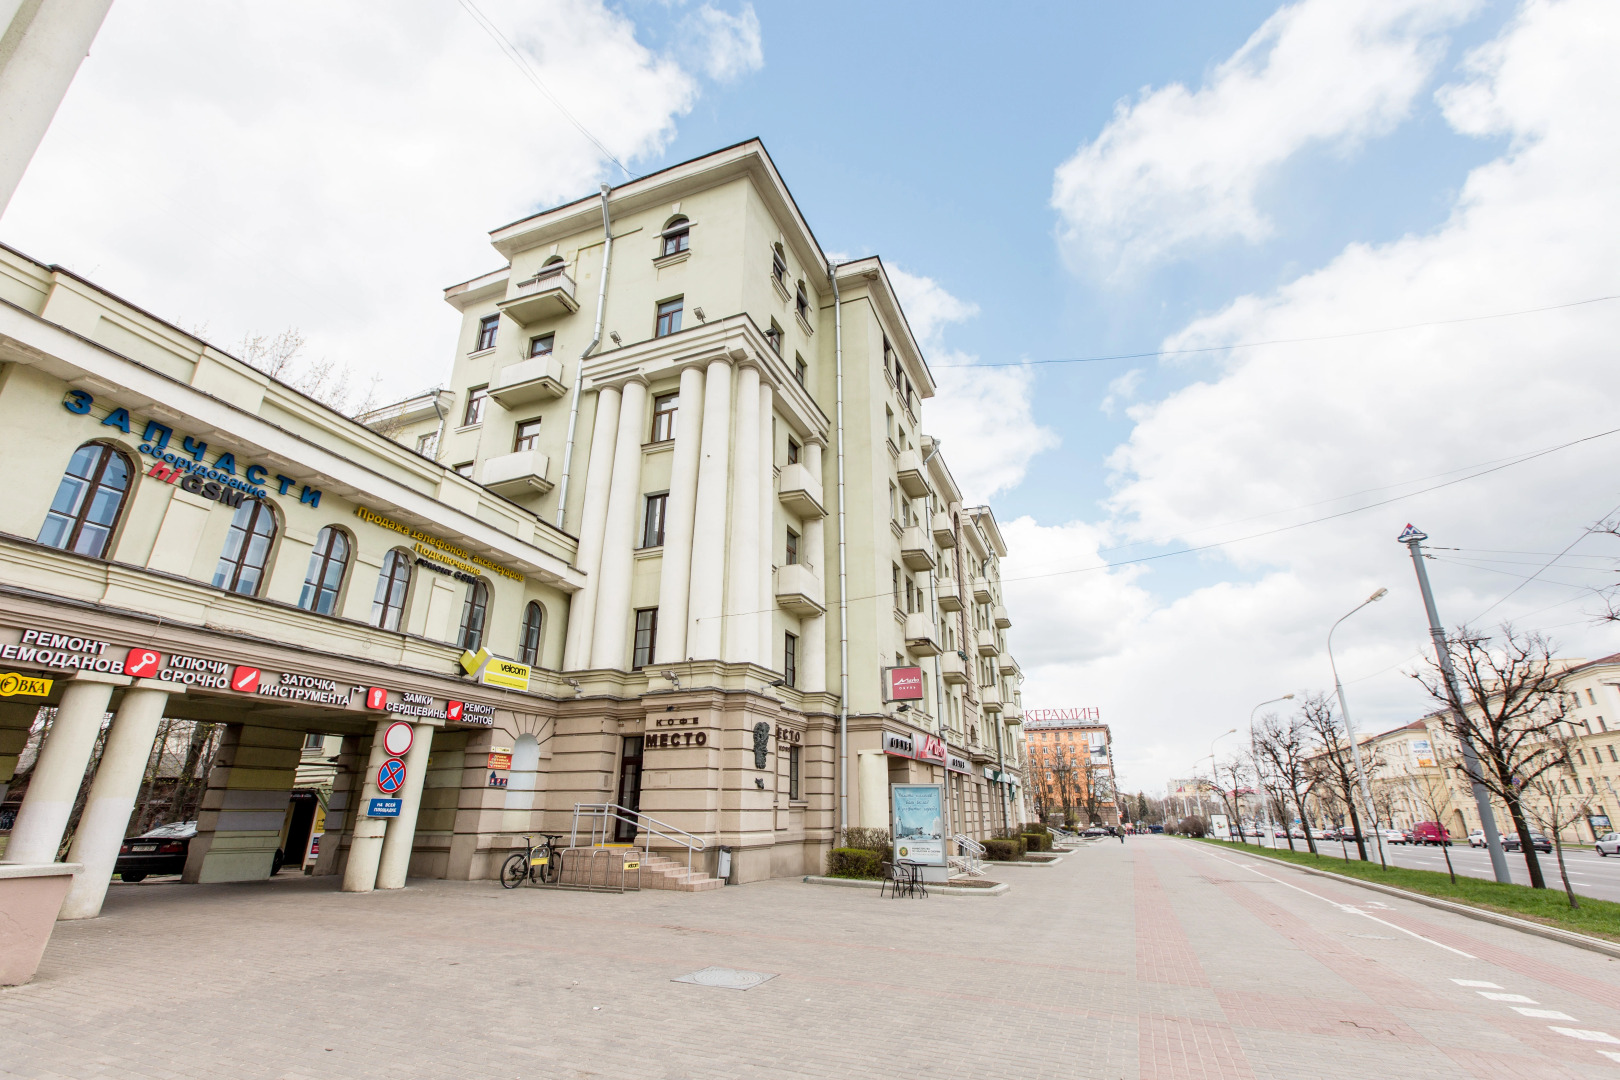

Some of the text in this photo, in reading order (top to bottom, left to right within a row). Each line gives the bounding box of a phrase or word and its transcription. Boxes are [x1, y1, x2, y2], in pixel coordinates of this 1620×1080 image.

[62, 389, 322, 509] ЗАПЧАСТИ
[139, 443, 267, 499] оборудование
[181, 475, 244, 509] GSM
[357, 506, 410, 535] Продажа
[415, 542, 482, 576] Подключение
[22, 629, 110, 655] РЕМОНТ
[169, 655, 229, 675] КЛЮЧИ
[500, 663, 527, 676] velcom
[0, 676, 46, 694] ОВКА
[159, 669, 229, 689] СРОЧНО
[280, 673, 337, 692] ЗАТОЧКА
[259, 683, 350, 705] ИНСТРУМЕНТА
[403, 692, 434, 706] ЗАМКИ
[385, 702, 447, 719] СЕРДЦЕВИНЫ
[464, 702, 495, 715] РЕМОНТ
[1025, 707, 1099, 722] КЕРАМИН
[462, 713, 493, 725] ЗОНТОВ
[656, 717, 699, 726] КОФЕ
[645, 732, 707, 748] МЕСТО
[777, 725, 800, 742] ЕСТО
